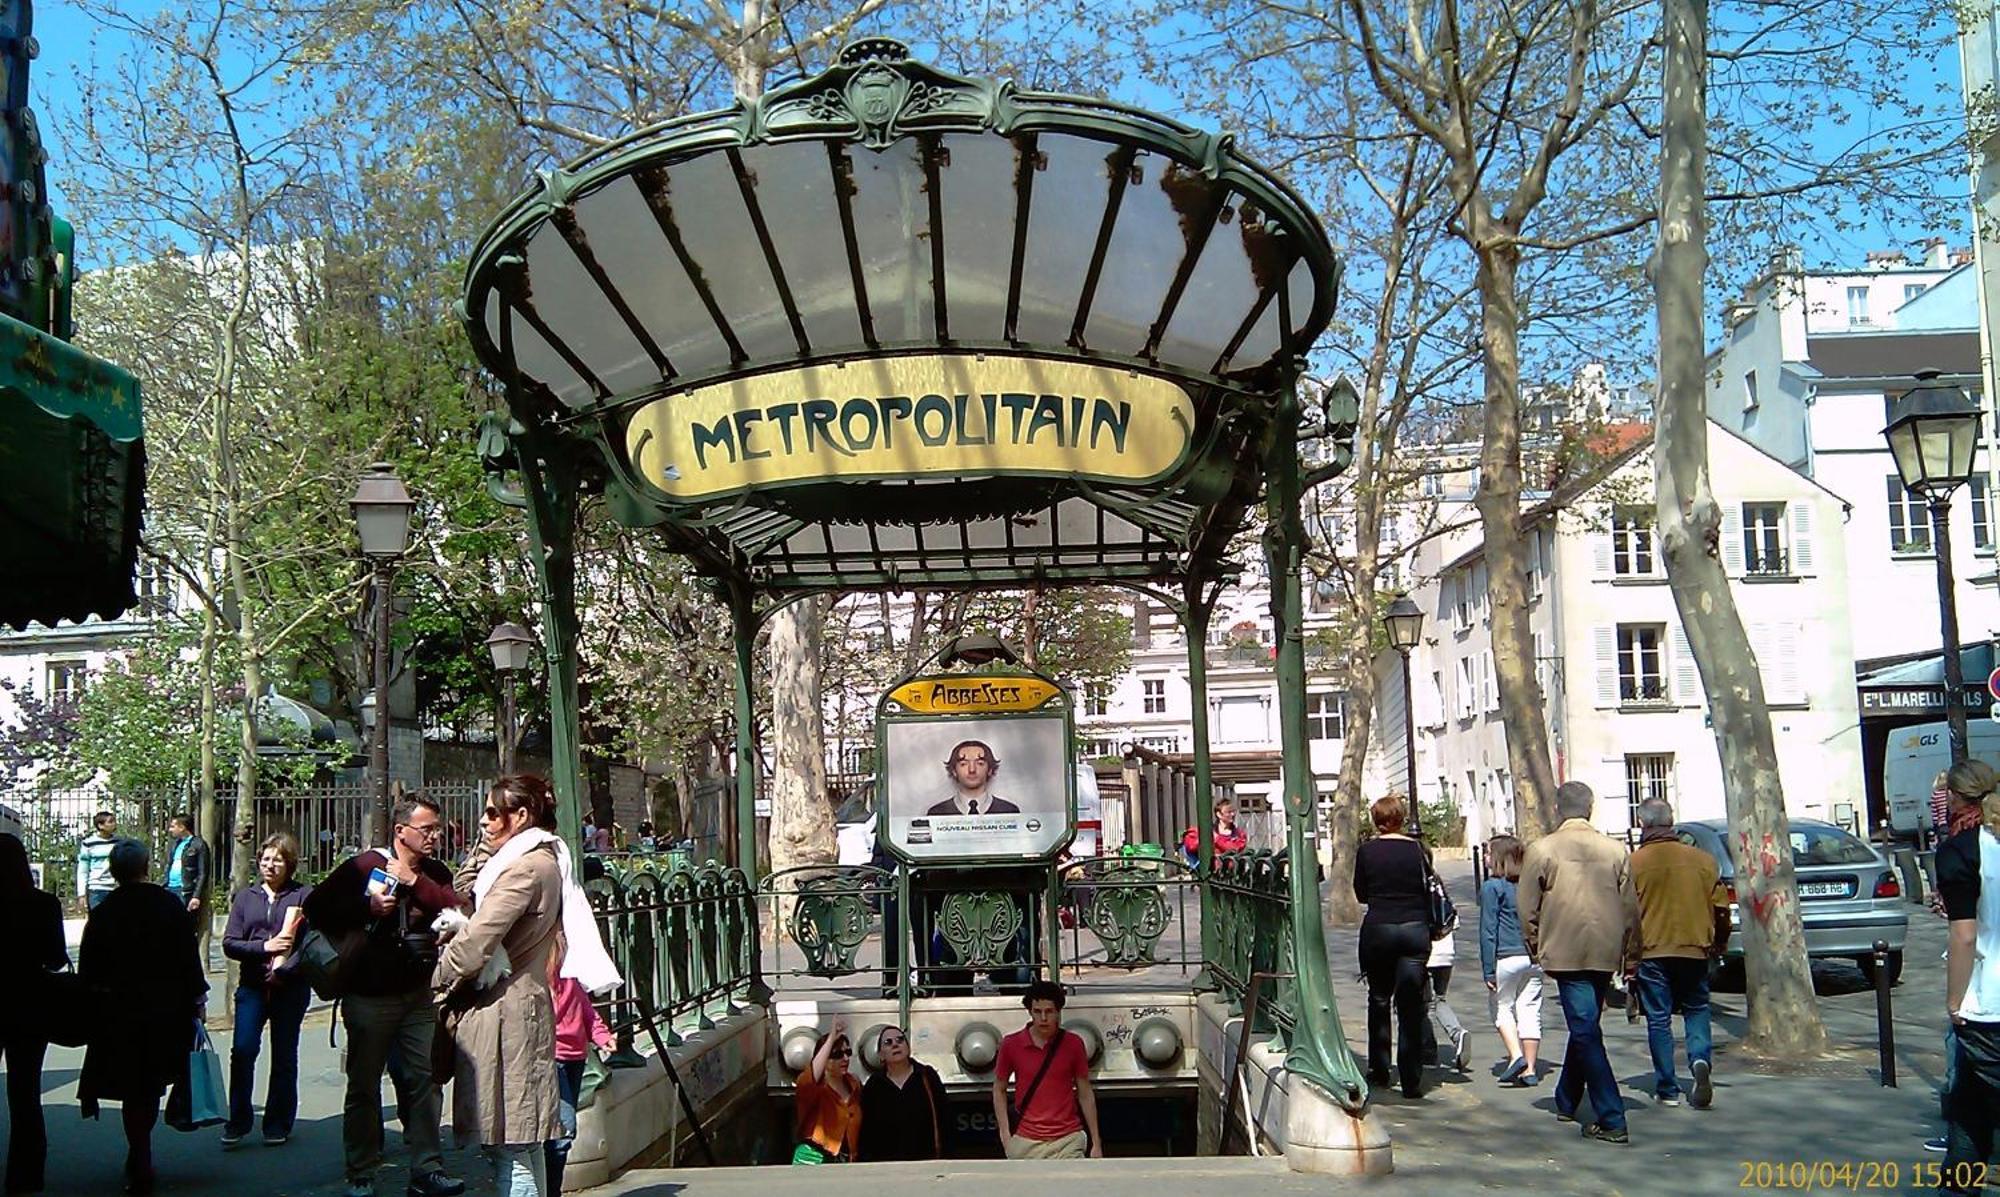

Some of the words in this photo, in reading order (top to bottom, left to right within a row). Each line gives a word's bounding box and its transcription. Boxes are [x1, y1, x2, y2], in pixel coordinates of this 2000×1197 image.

[691, 393, 1131, 470] METROPOLITAIN
[931, 682, 1021, 708] ABBESSES
[1962, 691, 1983, 706] ILS
[1920, 733, 1939, 746] GLS
[998, 823, 1018, 831] CUBE
